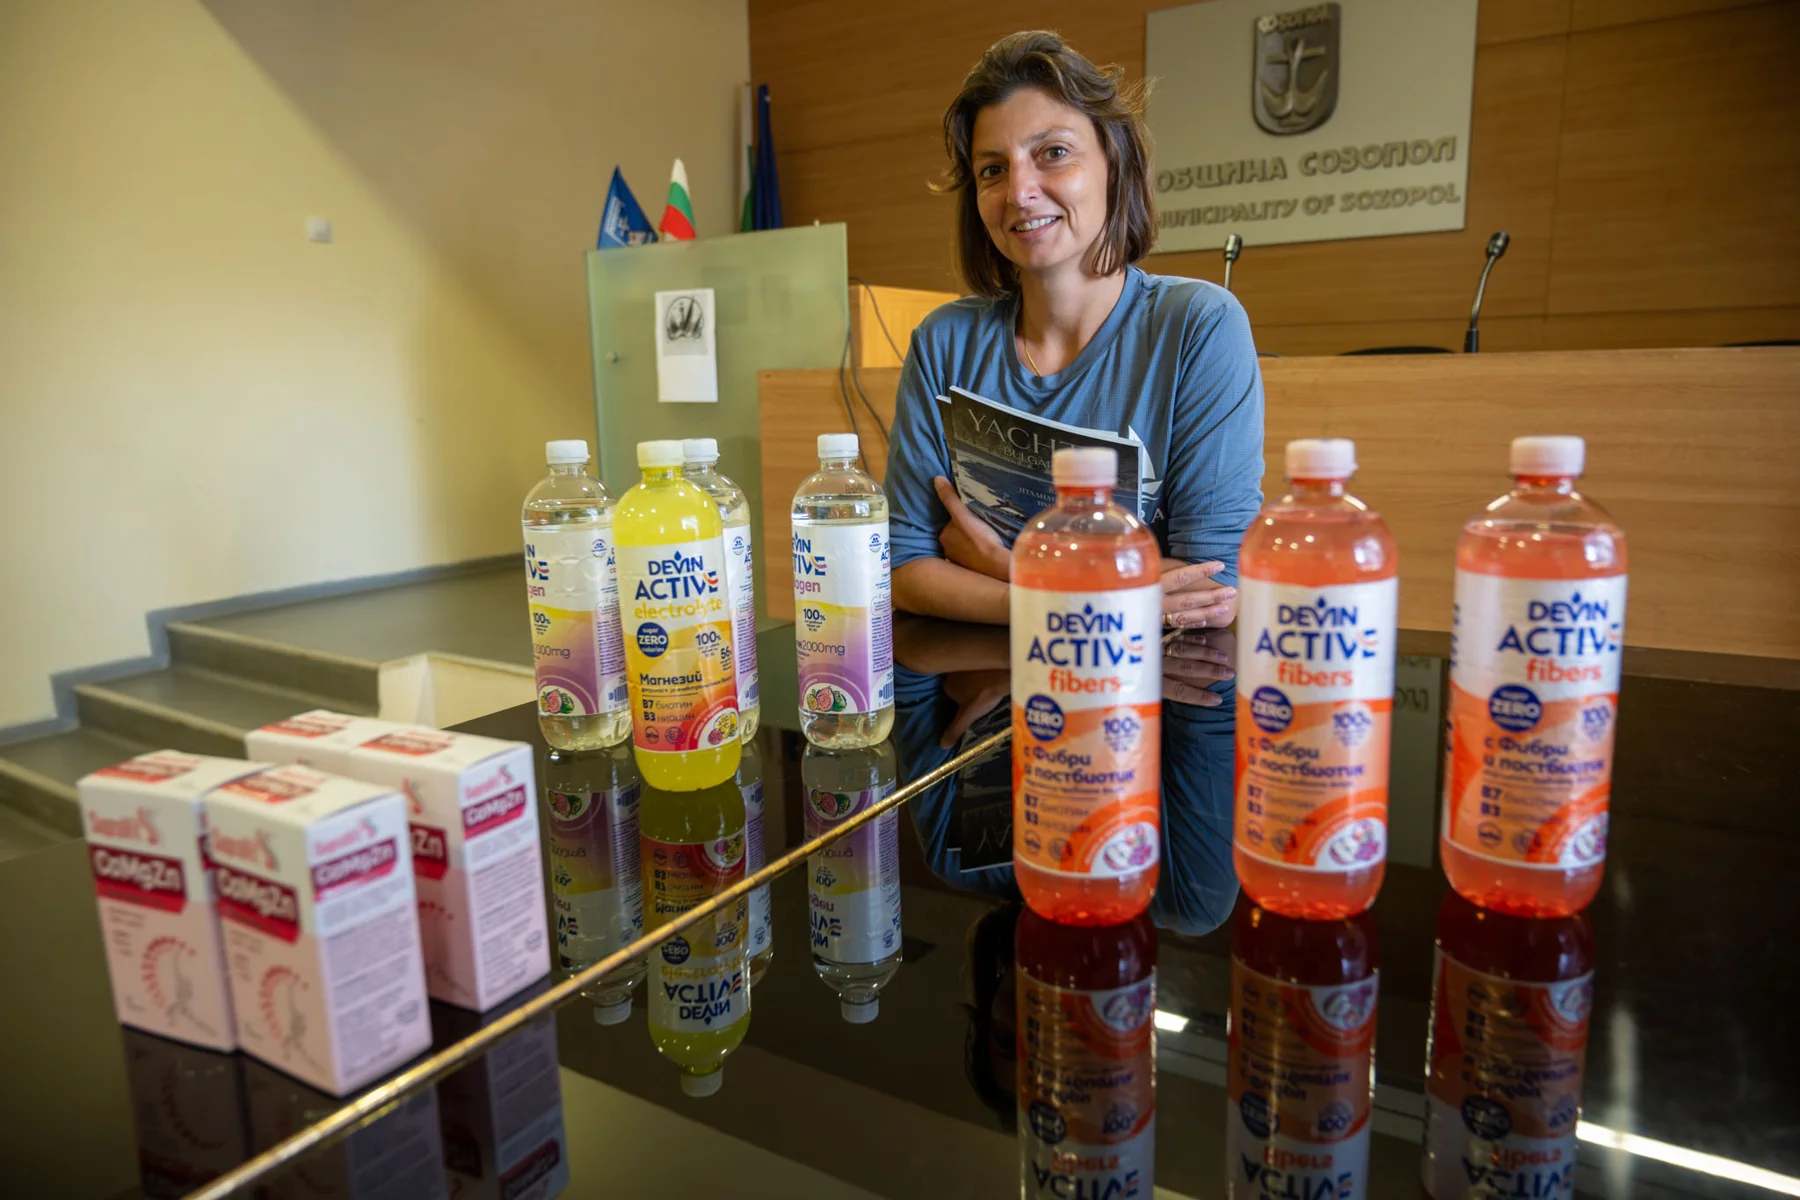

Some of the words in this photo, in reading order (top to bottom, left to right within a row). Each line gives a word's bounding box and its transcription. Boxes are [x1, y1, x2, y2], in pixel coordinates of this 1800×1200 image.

[1156, 156, 1288, 193] ОБЩИНА
[1299, 136, 1457, 177] СОЗОПОЛ
[1303, 194, 1335, 216] OF
[1340, 182, 1461, 213] SOZOPOL
[1003, 446, 1051, 470] BULGA
[647, 554, 704, 576] DEVIN
[635, 570, 719, 600] ACTIVE
[634, 597, 723, 620] electrolyte
[803, 608, 826, 621] 100%
[1277, 604, 1358, 627] DEVIN
[1528, 599, 1608, 623] DEVIN
[1047, 610, 1123, 633] DEVIN
[638, 635, 667, 645] ZERO
[1027, 634, 1144, 668] ACTIVE
[1256, 628, 1378, 661] ACTIVE
[1498, 623, 1621, 656] ACTIVE
[640, 670, 703, 686] Магнезий
[1048, 669, 1121, 694] fibers
[1277, 660, 1353, 687] fibers
[1525, 658, 1603, 684] fibers
[655, 700, 693, 710] биотин
[1026, 708, 1064, 729] ZERO
[1032, 745, 1092, 768] Фибри
[1258, 736, 1319, 761] Фибри
[1498, 736, 1569, 759] Фибри
[1034, 767, 1134, 784] постбиотик
[1258, 757, 1364, 780] постбиотик
[411, 828, 443, 858] Zn
[94, 850, 181, 893] CaMgZn
[215, 868, 297, 922] CaMgZn
